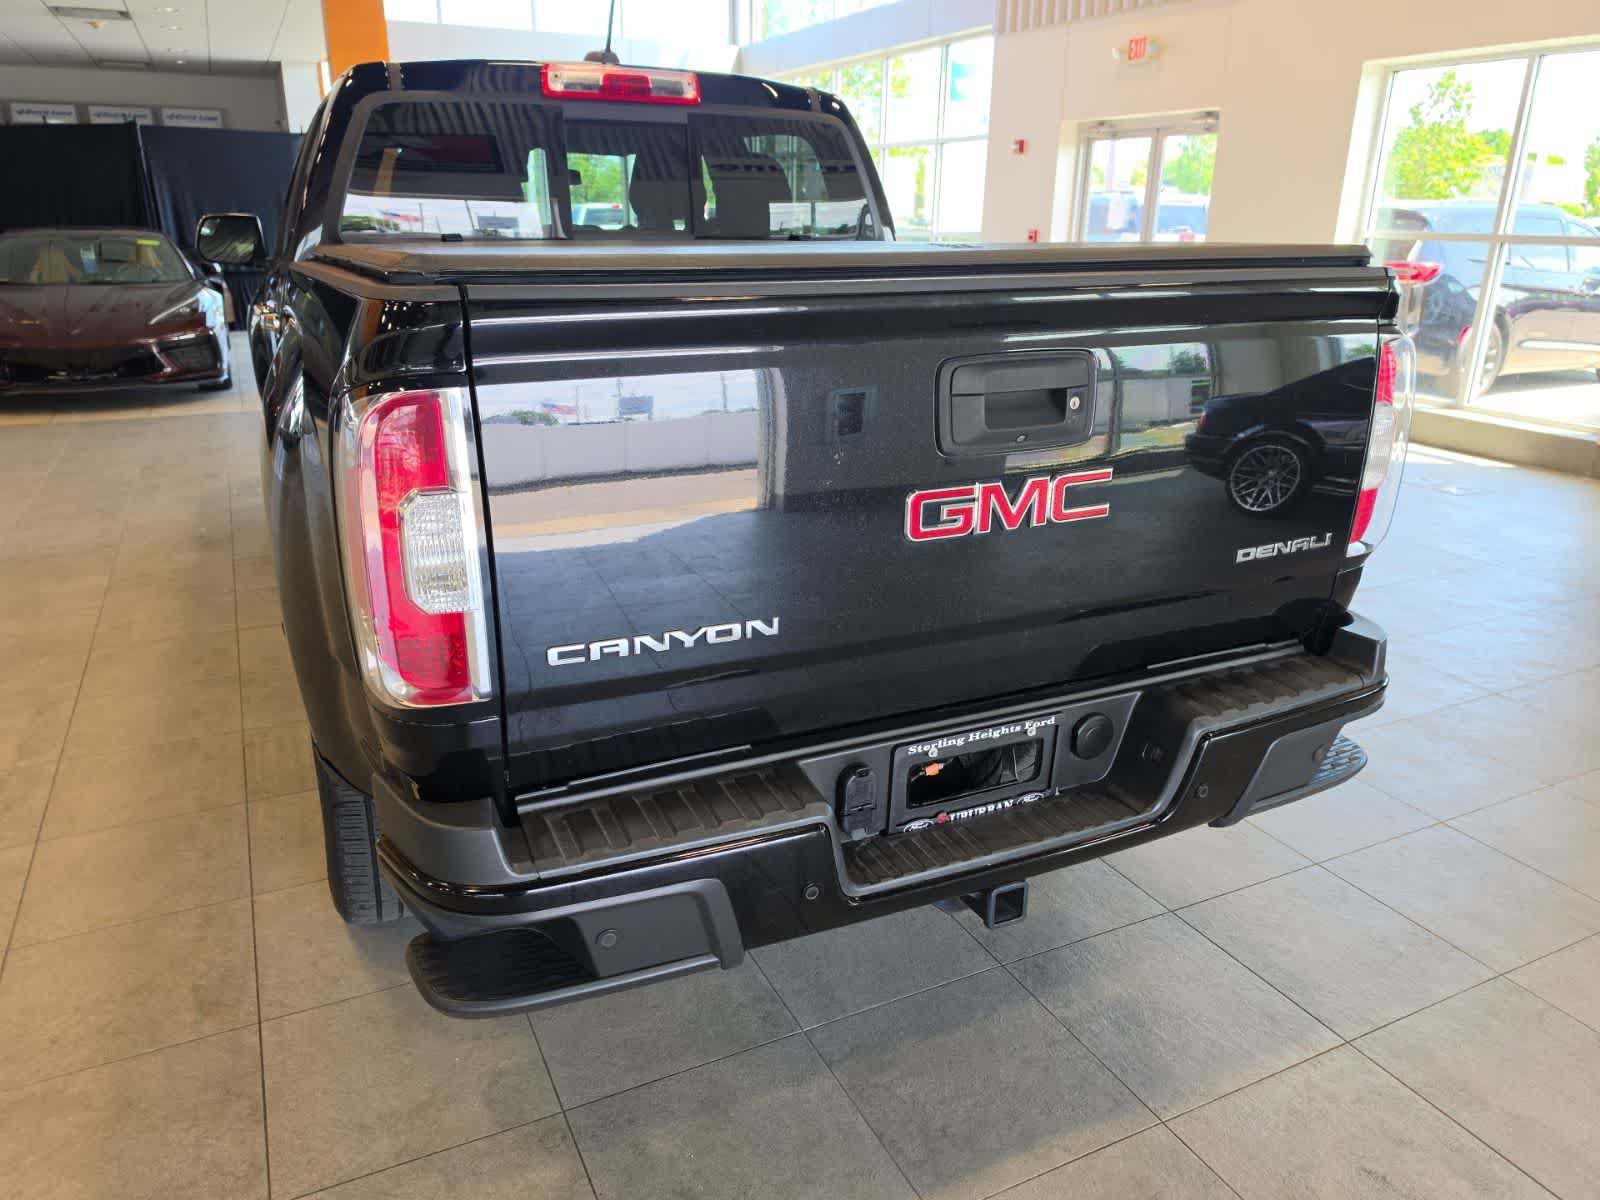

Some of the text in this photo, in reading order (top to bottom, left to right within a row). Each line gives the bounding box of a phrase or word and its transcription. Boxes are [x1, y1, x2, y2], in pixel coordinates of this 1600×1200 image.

[1128, 37, 1147, 60] EXIT
[904, 467, 1113, 542] GMC
[1235, 532, 1333, 564] DENALI
[546, 616, 780, 666] CANYON
[907, 716, 1056, 755] Sterling Heights Ford
